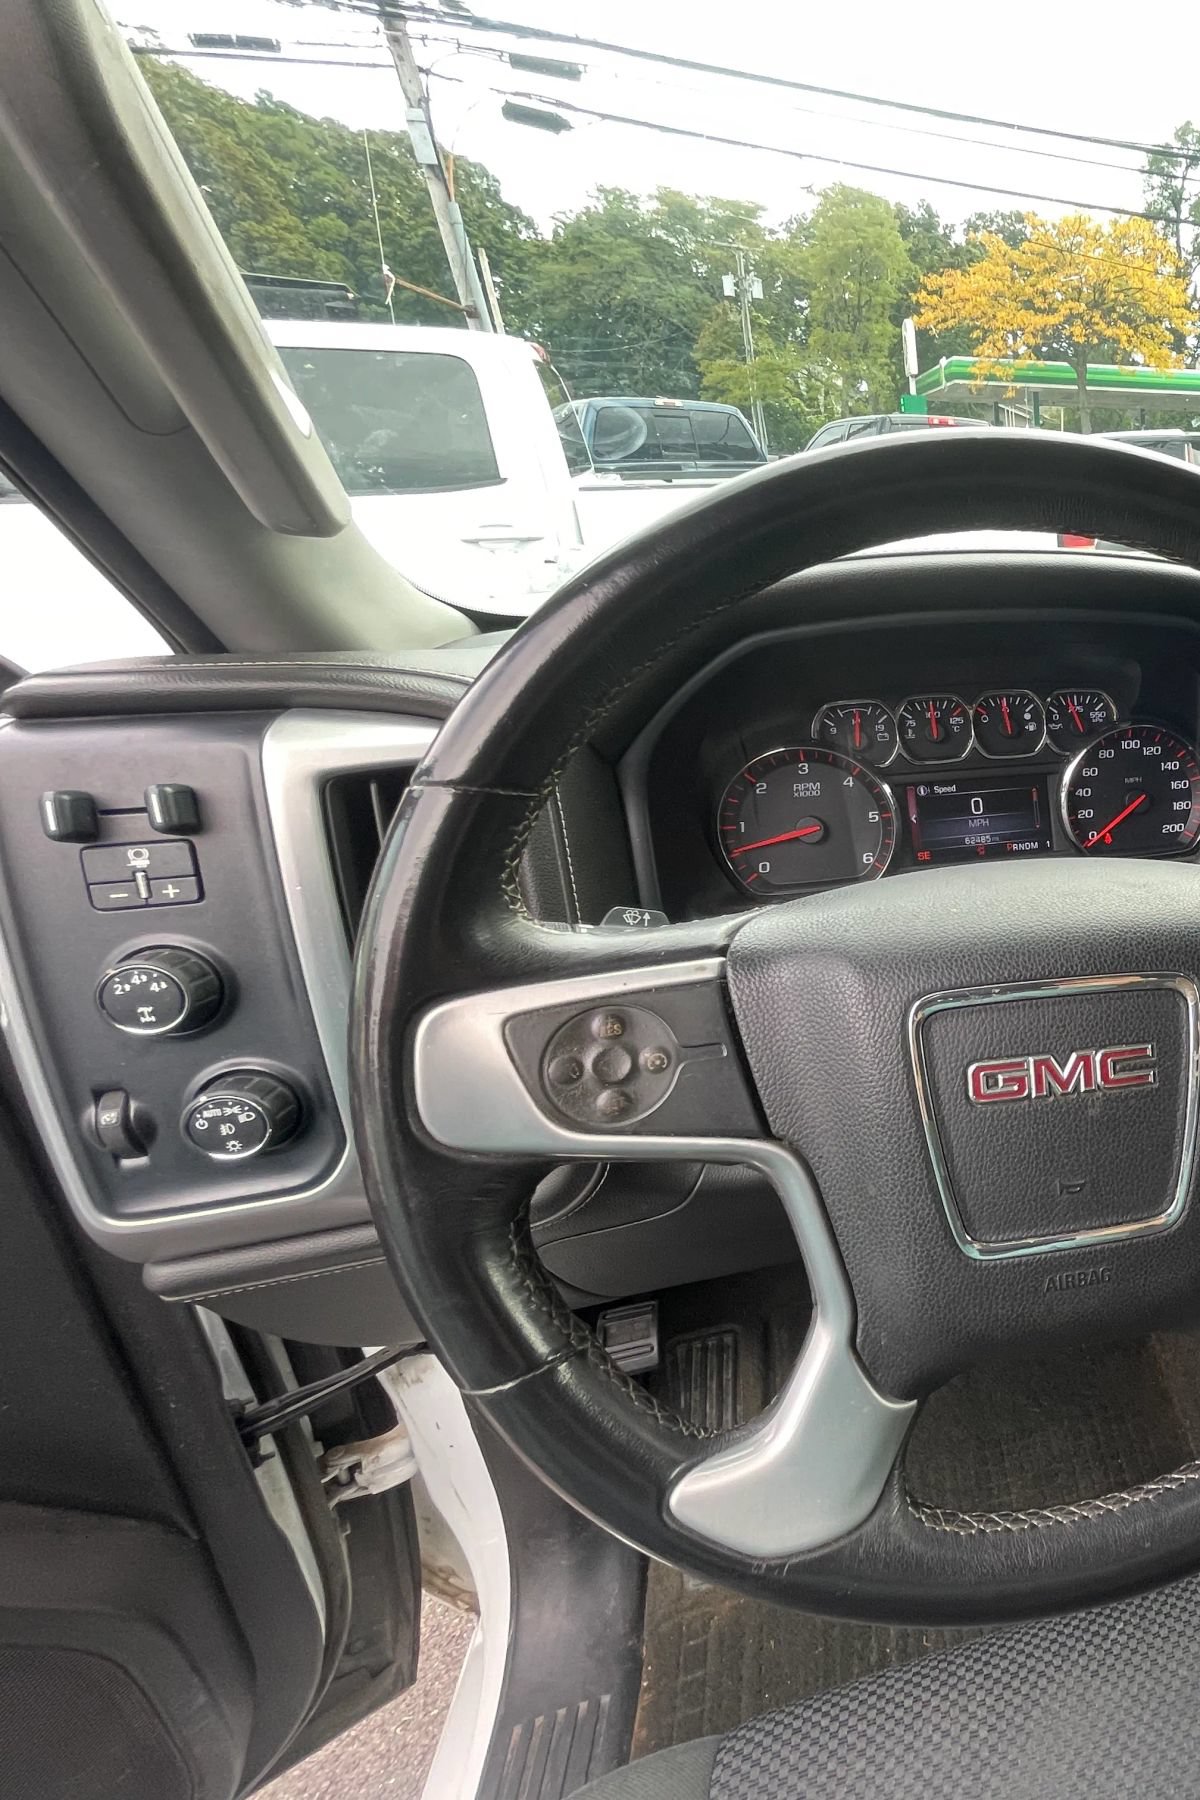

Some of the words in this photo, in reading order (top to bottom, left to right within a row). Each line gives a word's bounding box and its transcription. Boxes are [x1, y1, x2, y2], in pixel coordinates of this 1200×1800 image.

[905, 719, 916, 727] 75
[949, 716, 964, 725] 125
[875, 724, 885, 732] 19
[1120, 739, 1141, 751] 100
[1098, 749, 1115, 759] 80
[1142, 745, 1162, 757] 120
[797, 763, 809, 775] 3
[1082, 767, 1099, 777] 60
[1160, 761, 1180, 772] 140
[793, 782, 821, 791] RPM
[843, 777, 855, 788] 4
[1170, 780, 1190, 790] 160
[755, 782, 768, 795] 2
[933, 784, 957, 794] Speed
[1075, 787, 1092, 798] 40
[970, 797, 984, 815] 0
[1172, 800, 1192, 811] 180
[868, 811, 880, 823] 5
[1077, 808, 1094, 819] 20
[739, 821, 746, 833] 1
[968, 818, 990, 828] MPH
[1161, 823, 1185, 834] 200
[964, 835, 991, 845] 62485
[1088, 831, 1098, 841] 0
[862, 852, 874, 864] 6
[917, 851, 931, 861] SE
[758, 861, 771, 874] 0
[966, 1043, 1157, 1103] GMC
[1044, 1267, 1112, 1292] AIRBAG
